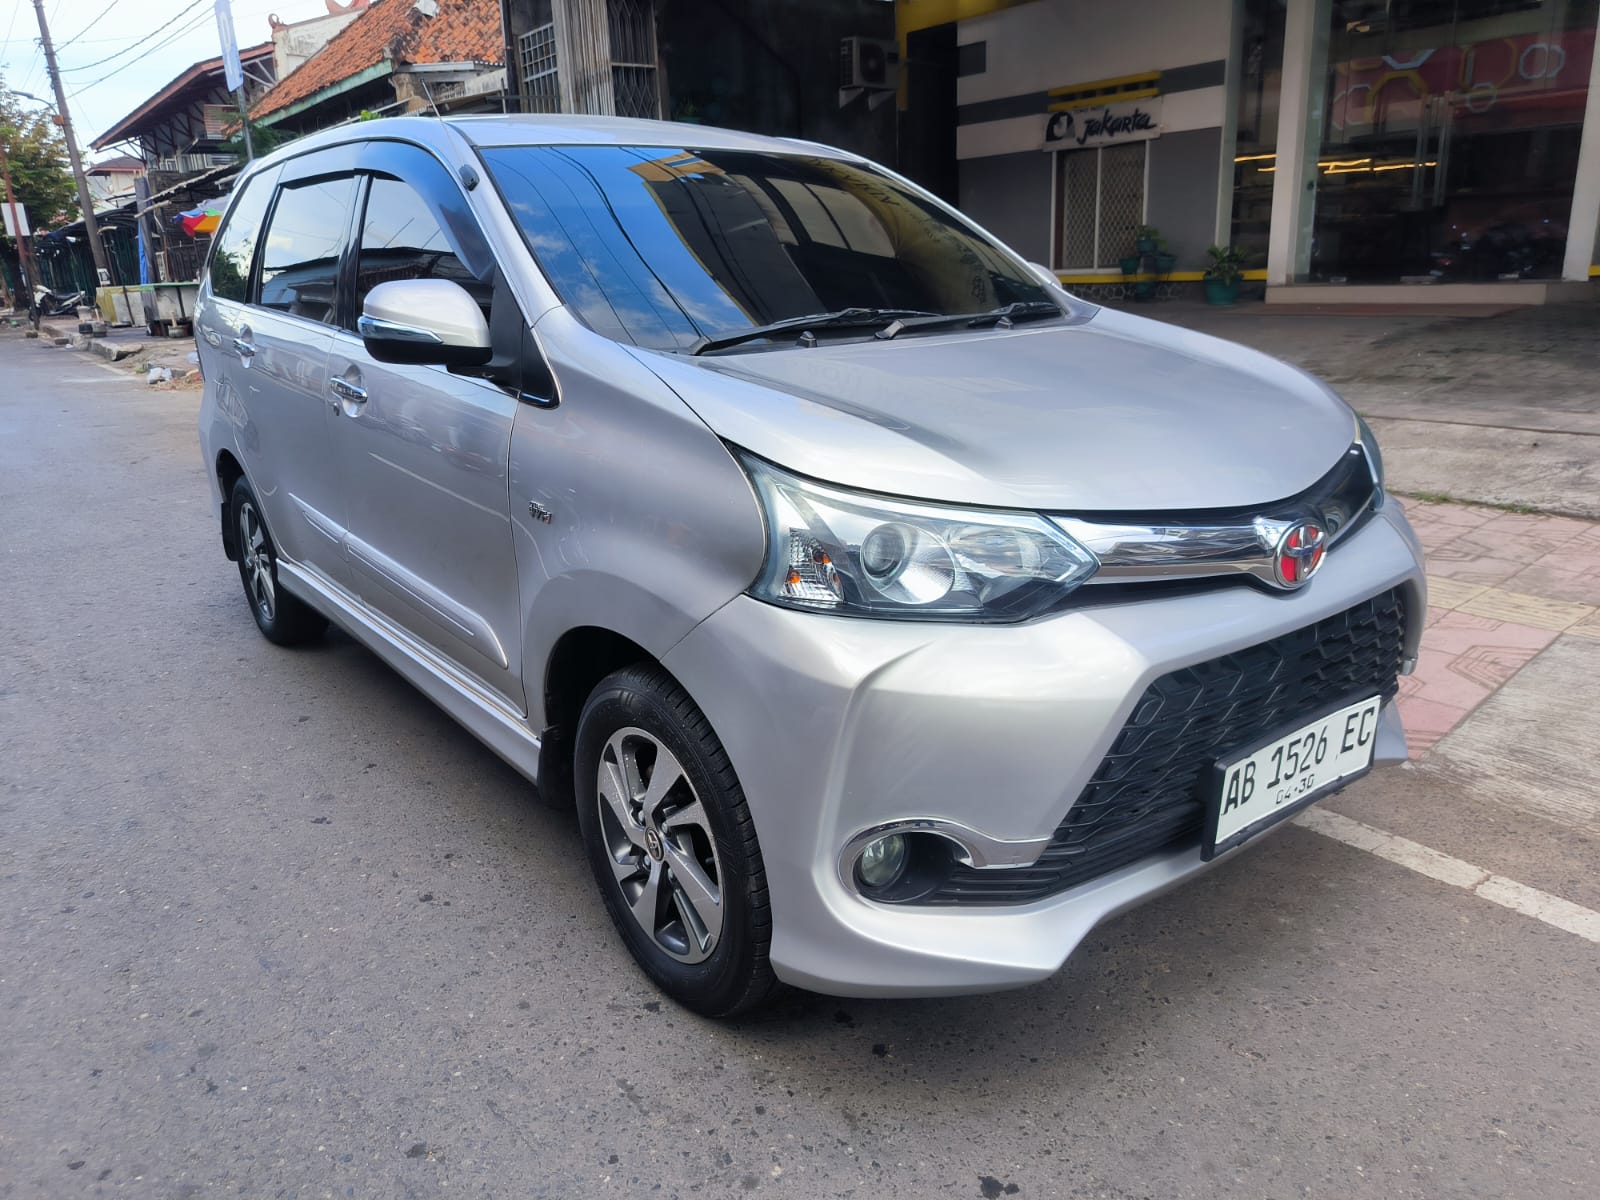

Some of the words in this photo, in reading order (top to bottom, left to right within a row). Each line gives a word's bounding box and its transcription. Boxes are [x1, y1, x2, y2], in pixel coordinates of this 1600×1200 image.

[1222, 761, 1257, 816] AB
[1267, 725, 1328, 789] 1526
[1340, 706, 1375, 754] EC
